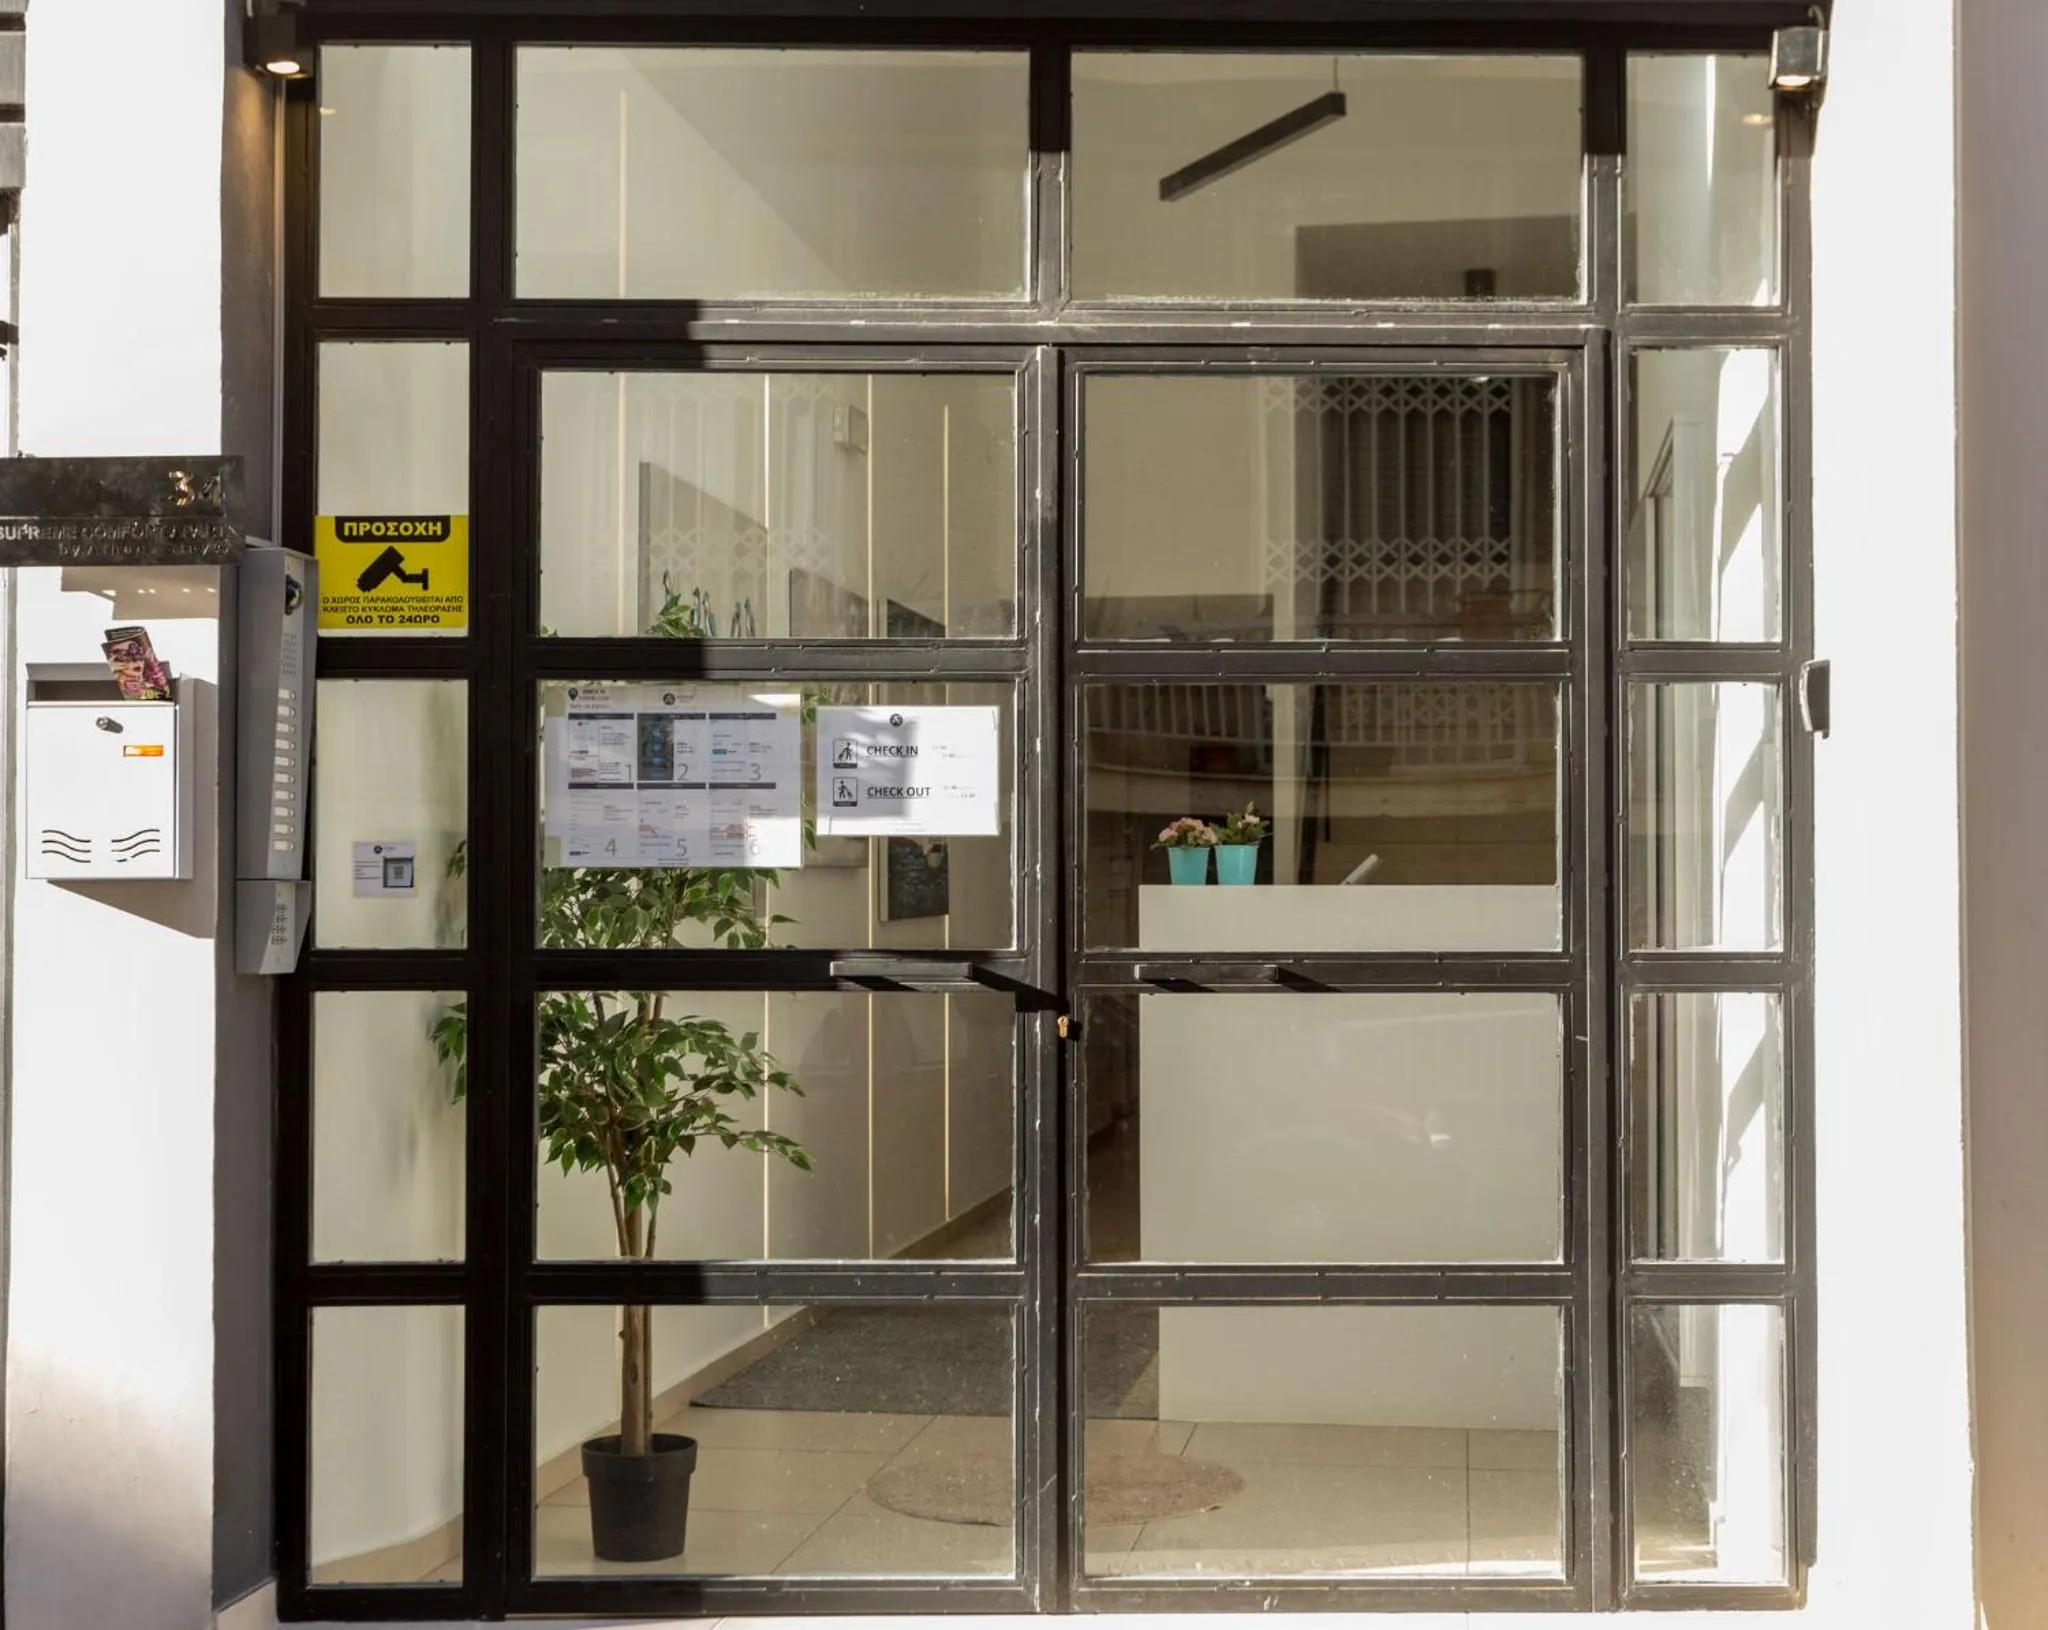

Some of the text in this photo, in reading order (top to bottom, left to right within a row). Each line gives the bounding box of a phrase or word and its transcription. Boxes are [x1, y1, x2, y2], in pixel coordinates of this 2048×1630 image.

[343, 522, 442, 536] ΠΡΟΣΟΧΗ
[346, 615, 440, 624] ΟΛΟ ΤΟ 24ΩΡΟ
[866, 745, 904, 757] CHECK
[905, 745, 919, 757] IN
[625, 764, 632, 781] 1
[678, 763, 689, 781] 2
[750, 762, 762, 781] 3
[867, 786, 904, 797] CHECK
[906, 786, 932, 797] OUT
[604, 838, 617, 857] 4
[676, 838, 689, 857] 5
